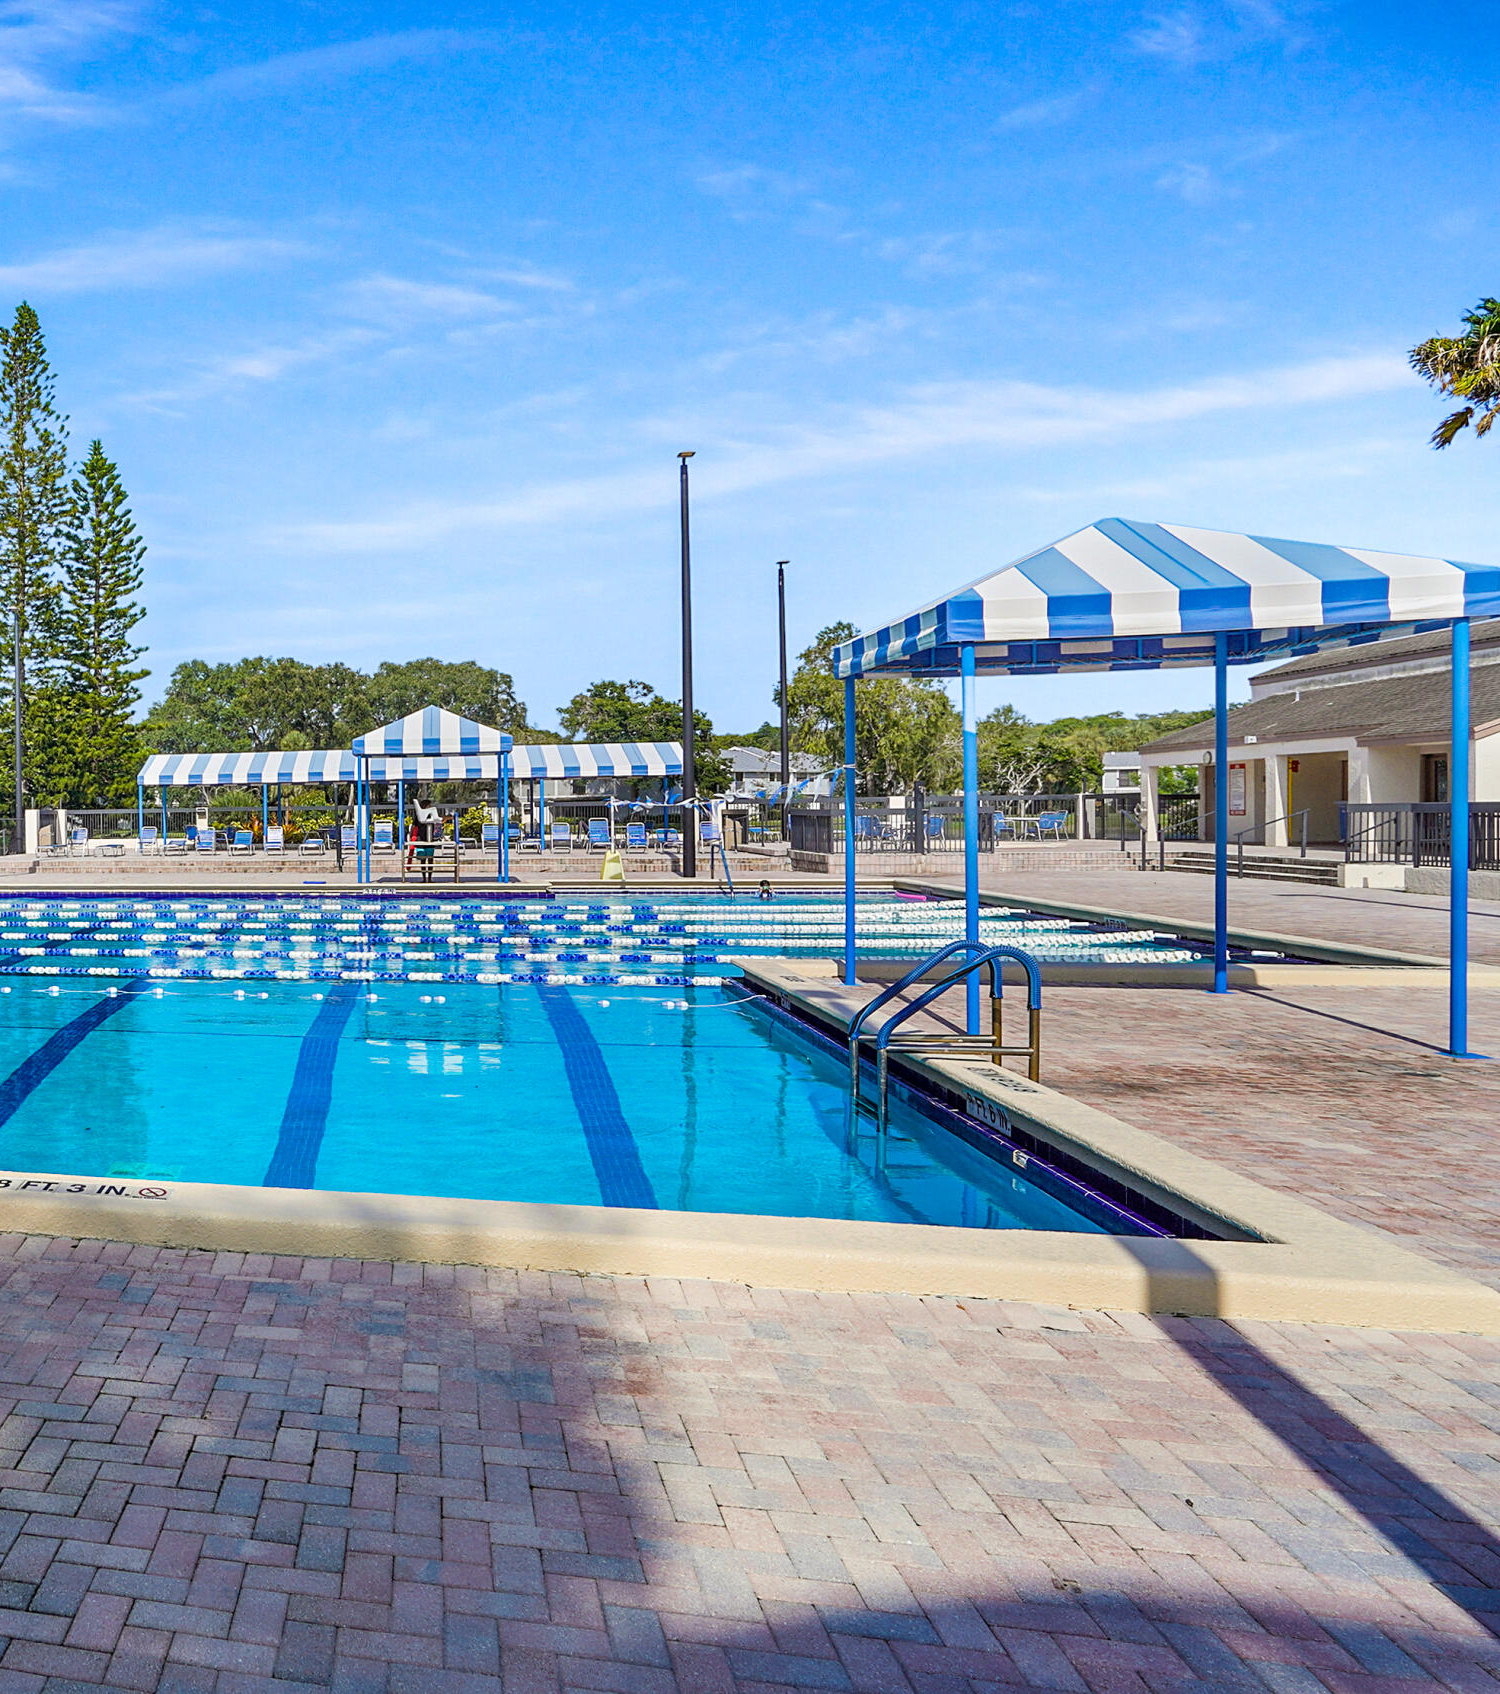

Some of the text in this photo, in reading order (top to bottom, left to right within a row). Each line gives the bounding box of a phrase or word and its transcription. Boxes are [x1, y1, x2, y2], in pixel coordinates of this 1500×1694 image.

[21, 1180, 60, 1192] FT.
[66, 1184, 87, 1193] 3
[96, 1184, 130, 1197] IN.
